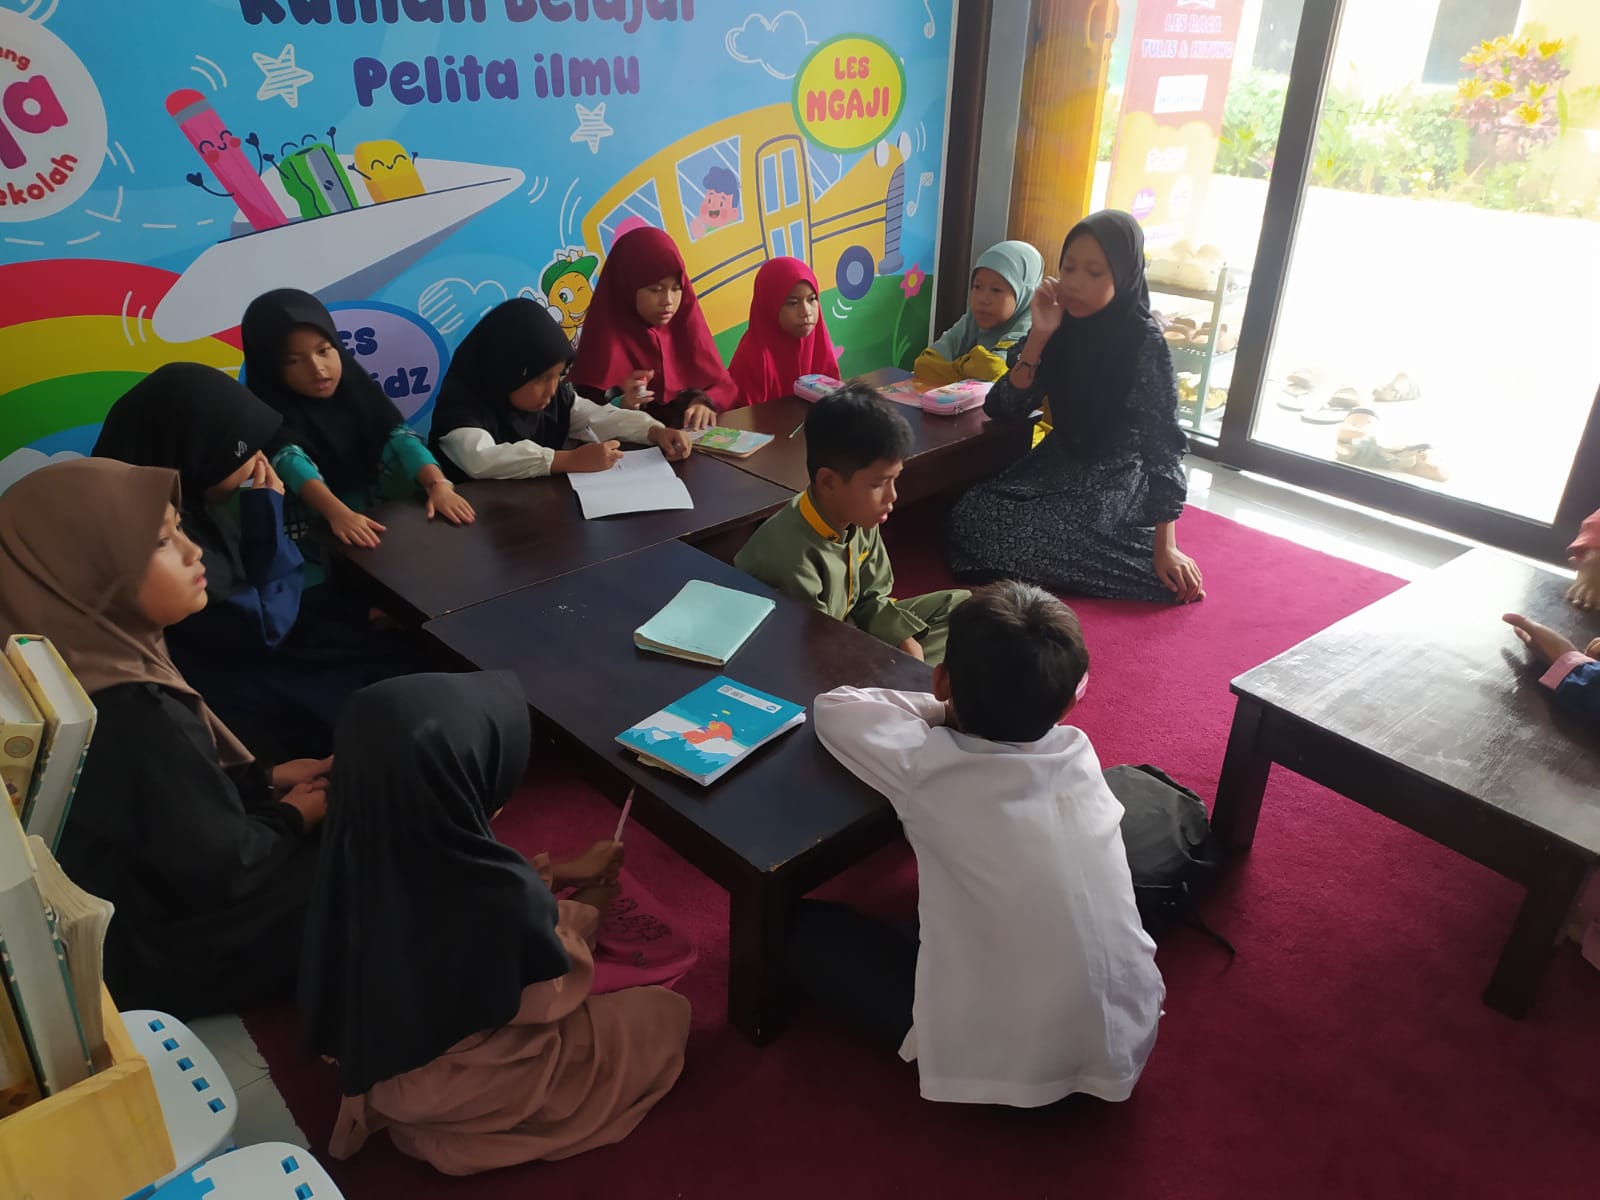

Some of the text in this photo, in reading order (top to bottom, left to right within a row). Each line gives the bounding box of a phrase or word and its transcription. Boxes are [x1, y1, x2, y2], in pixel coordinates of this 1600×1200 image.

[353, 53, 641, 107] Pelita ilmu
[834, 56, 870, 80] LES
[806, 86, 890, 122] NGAJI
[337, 326, 379, 357] ES
[370, 366, 432, 399] dz
